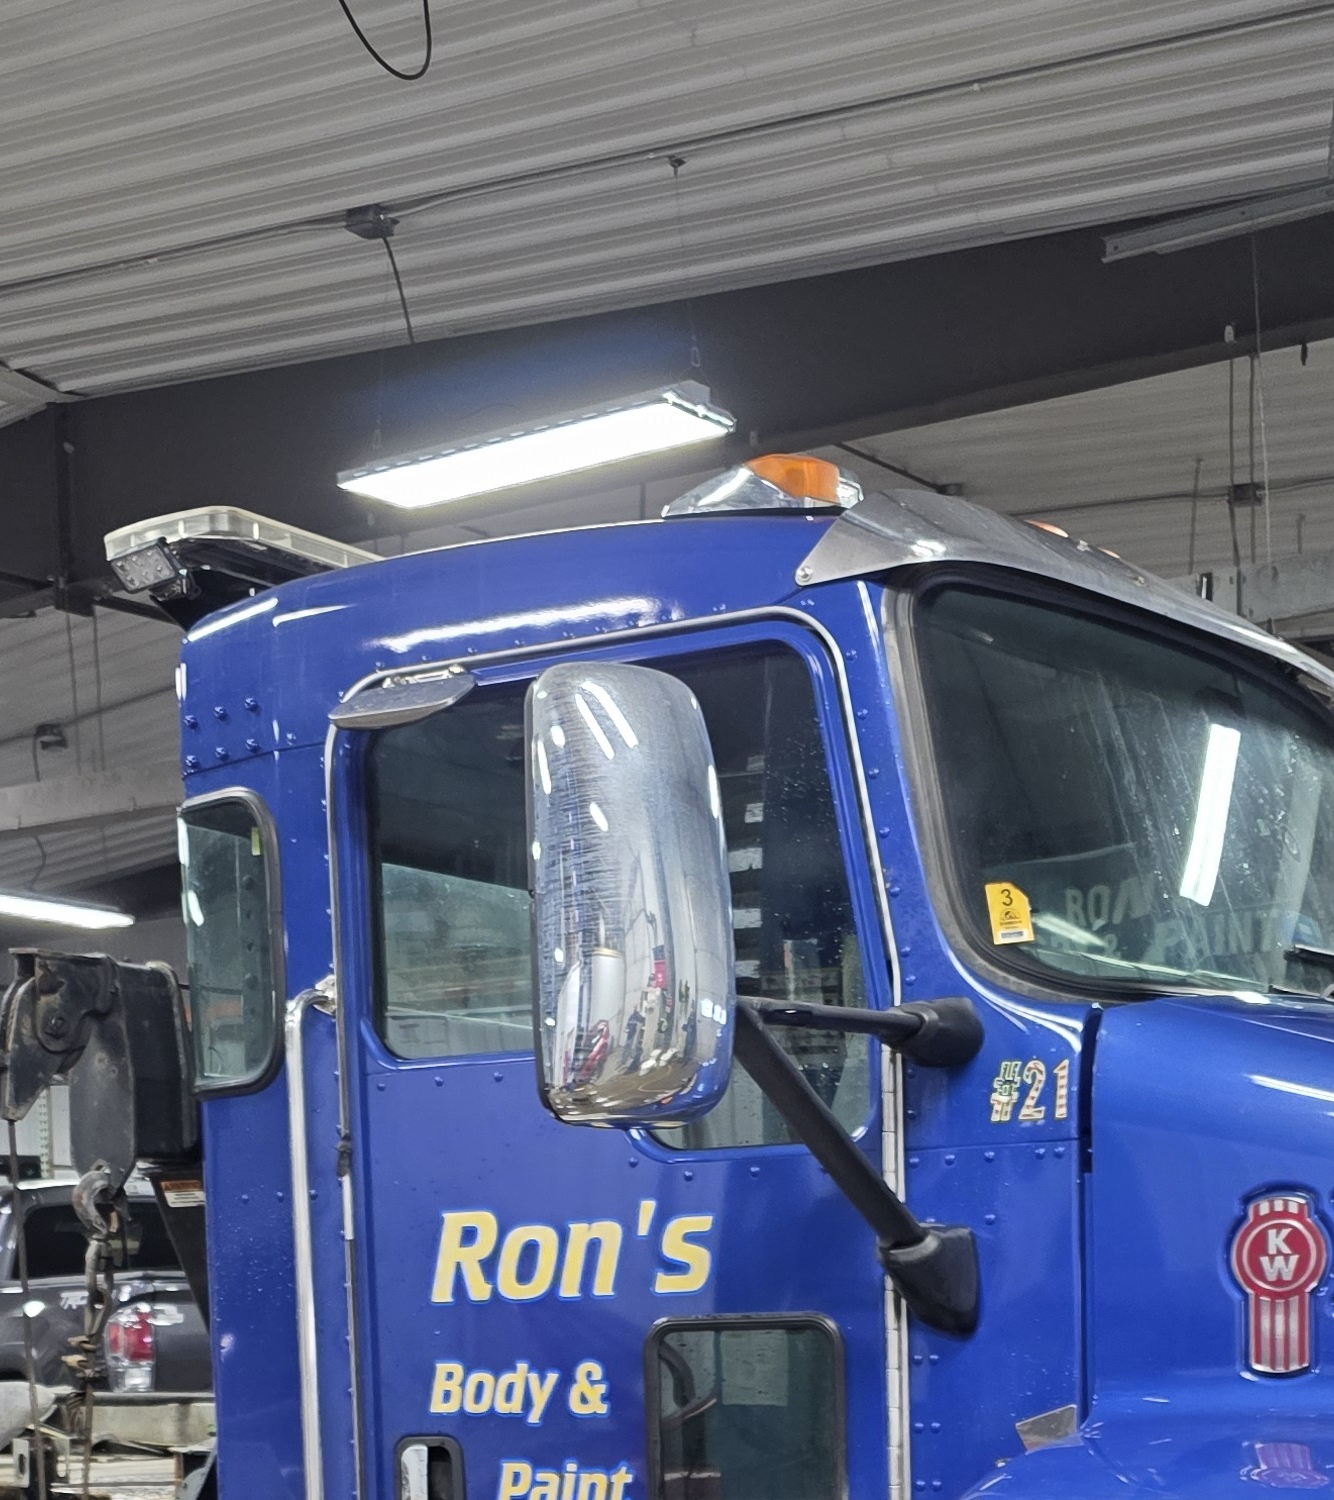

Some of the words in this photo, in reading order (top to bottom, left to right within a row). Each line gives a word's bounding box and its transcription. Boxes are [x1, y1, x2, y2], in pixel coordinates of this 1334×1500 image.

[1001, 888, 1013, 906] 3
[430, 1198, 715, 1304] Ron's
[430, 1361, 559, 1425] Body
[568, 1361, 610, 1417] &
